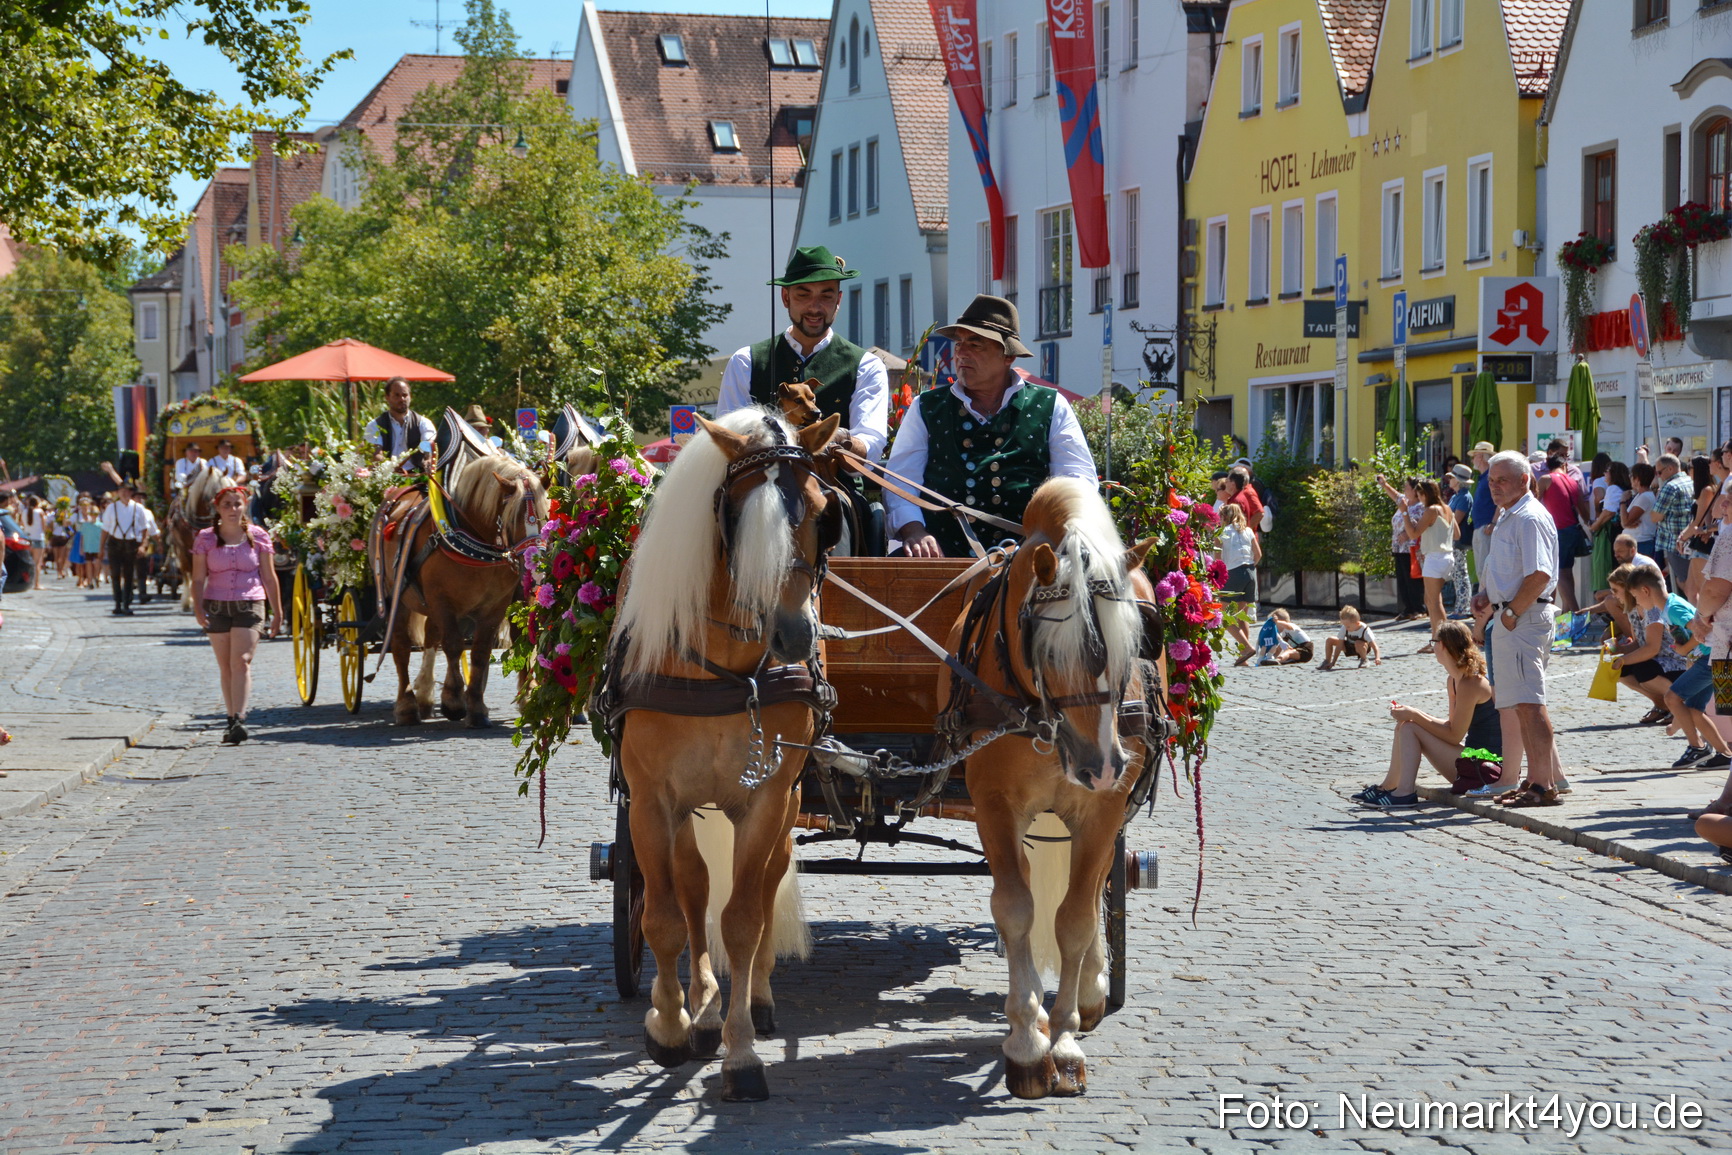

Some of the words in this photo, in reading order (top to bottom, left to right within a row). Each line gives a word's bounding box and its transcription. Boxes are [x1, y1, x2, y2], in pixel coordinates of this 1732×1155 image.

[1261, 152, 1300, 194] HOTEL
[1311, 144, 1356, 179] Lehmeier
[1337, 263, 1345, 302] P
[1308, 323, 1356, 333] TAIFN
[1395, 299, 1404, 339] P
[1255, 341, 1311, 369] Restaurant
[1653, 374, 1673, 387] ATHAUS
[1675, 371, 1703, 385] APOTHEKE
